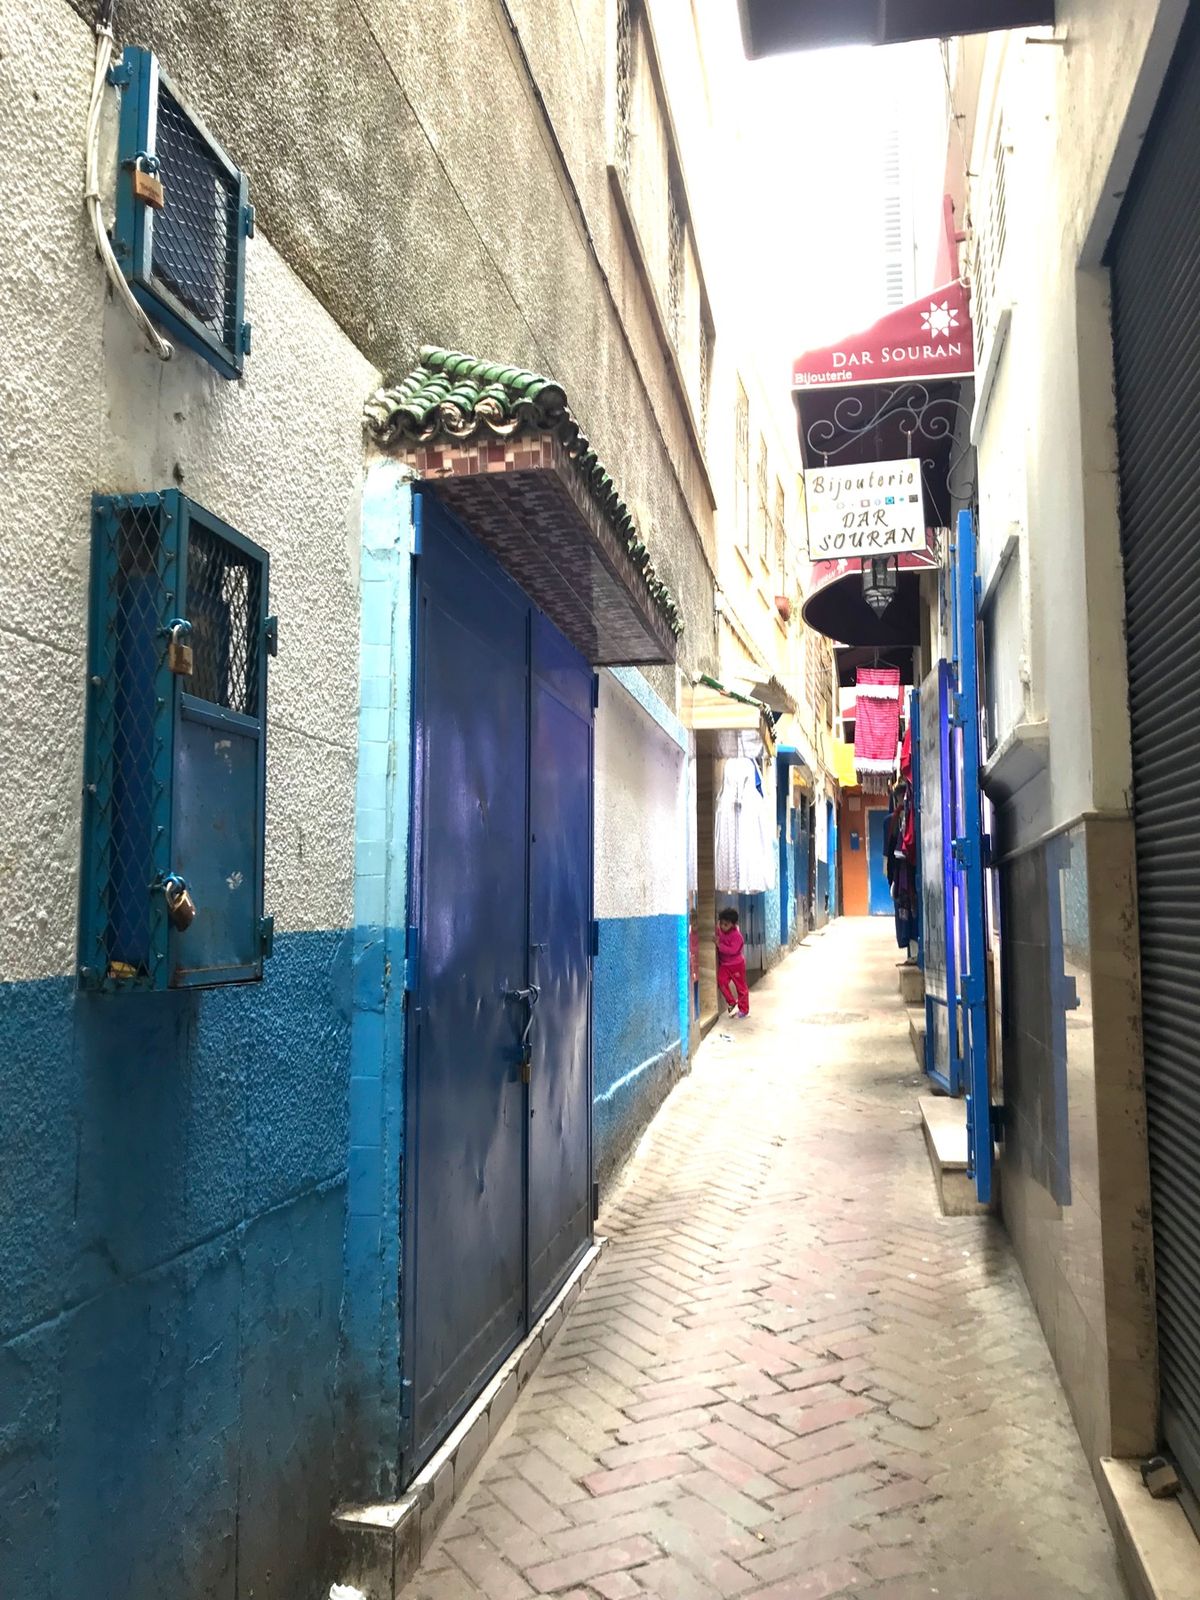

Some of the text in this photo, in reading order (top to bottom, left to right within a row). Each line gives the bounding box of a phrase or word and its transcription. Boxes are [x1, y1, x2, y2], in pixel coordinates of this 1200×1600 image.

[832, 343, 961, 367] DAR SOURAN
[794, 370, 853, 385] Bijouterie
[812, 470, 914, 501] Bijouterie
[842, 508, 888, 528] DAR
[819, 527, 915, 551] SOURAN
